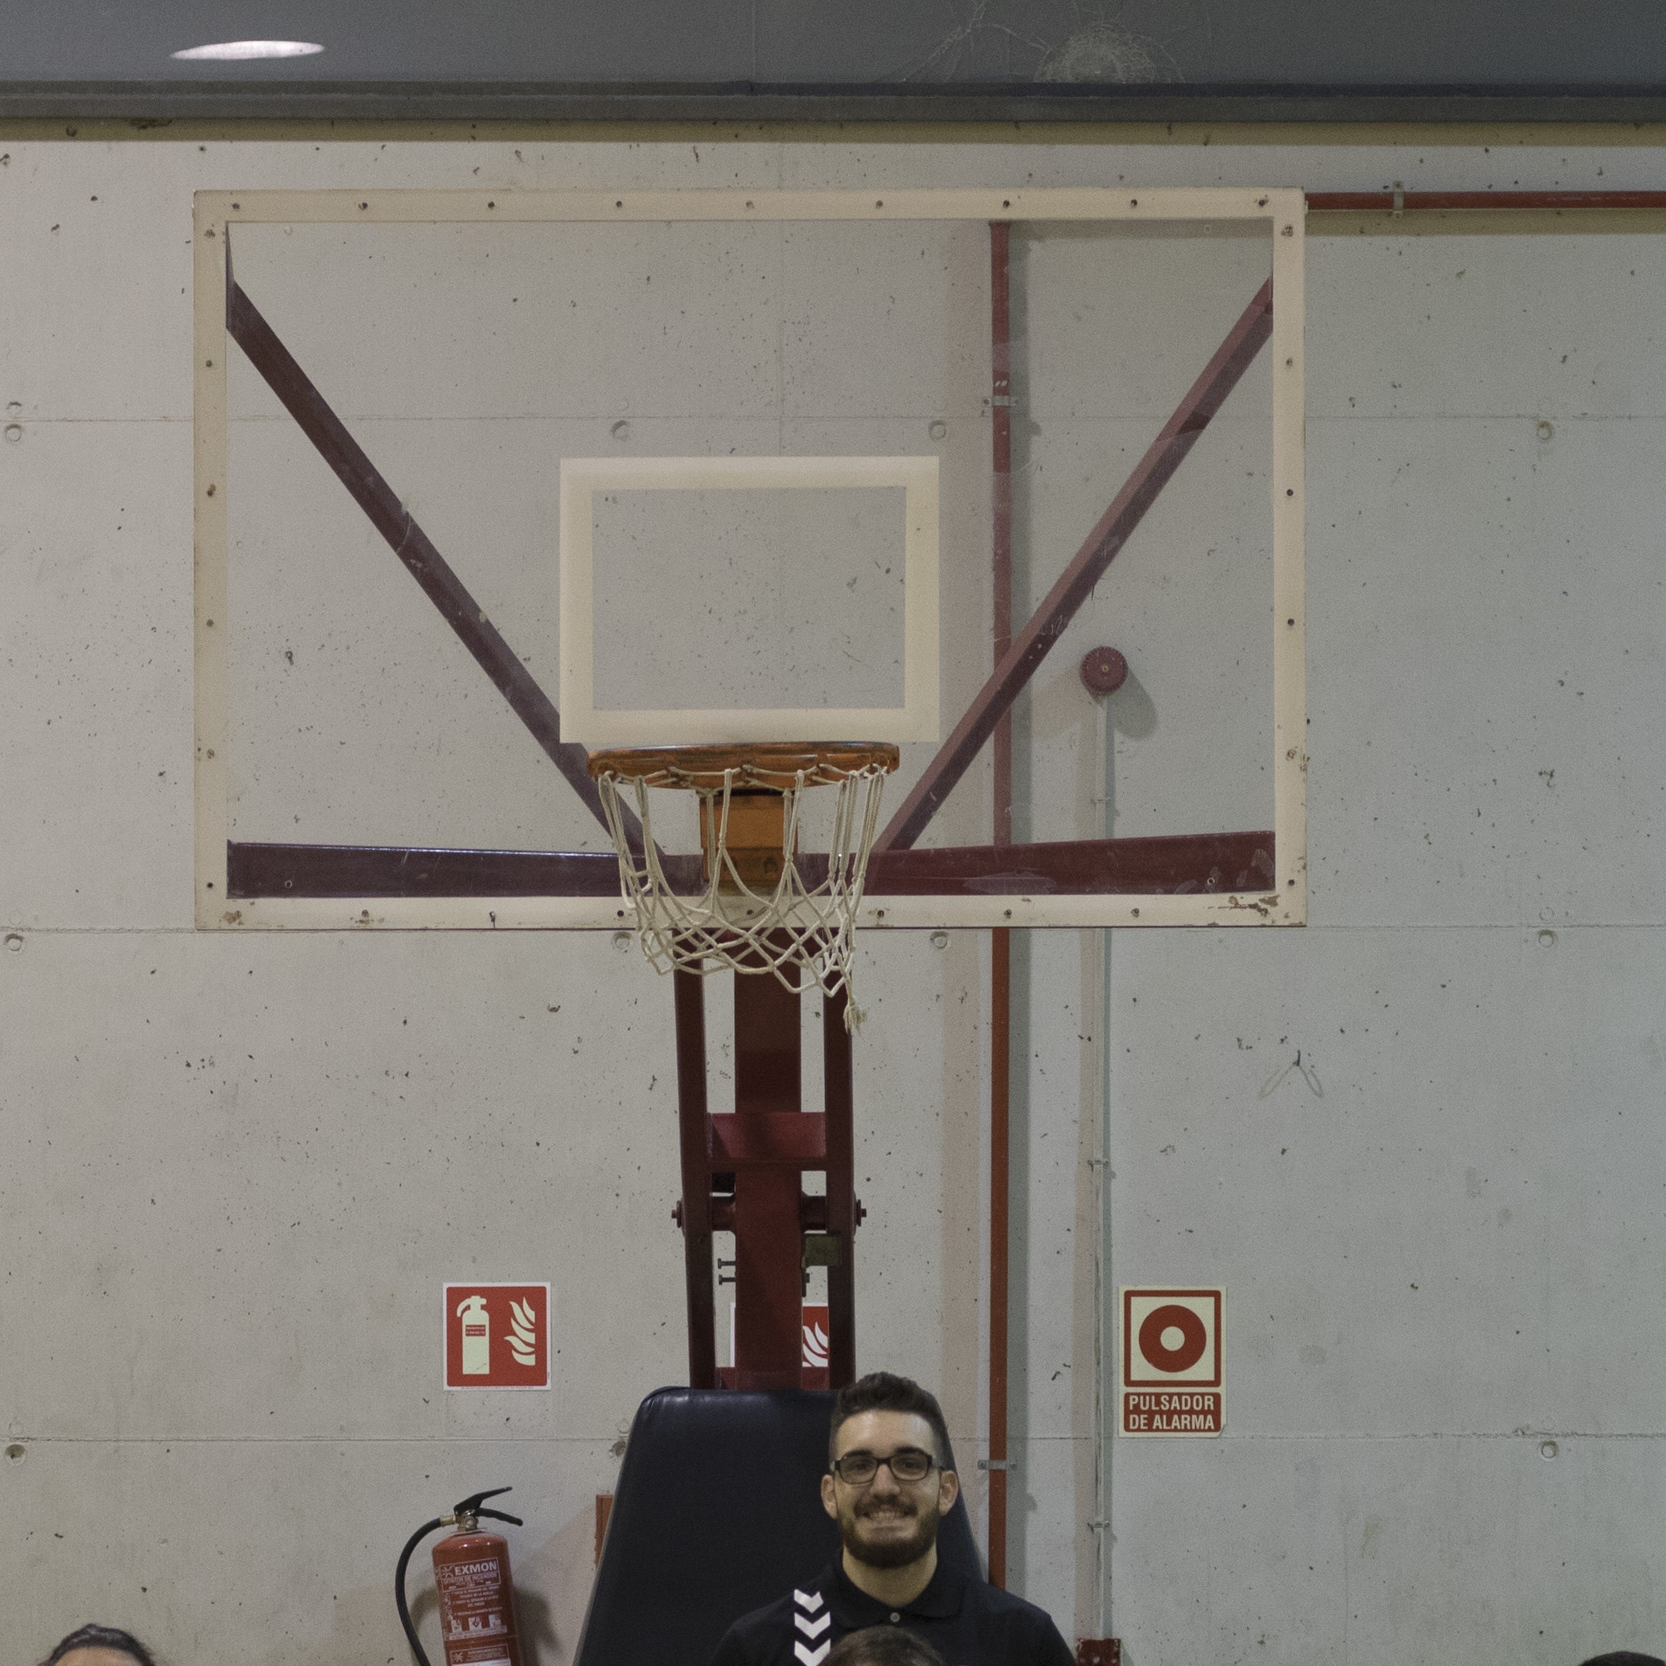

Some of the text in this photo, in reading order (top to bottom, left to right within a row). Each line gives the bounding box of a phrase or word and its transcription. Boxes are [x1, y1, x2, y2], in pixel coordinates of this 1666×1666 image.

[1129, 1395, 1214, 1411] PULSADOR
[1129, 1414, 1215, 1430] DE ALARMA
[454, 1561, 498, 1576] EXMON
